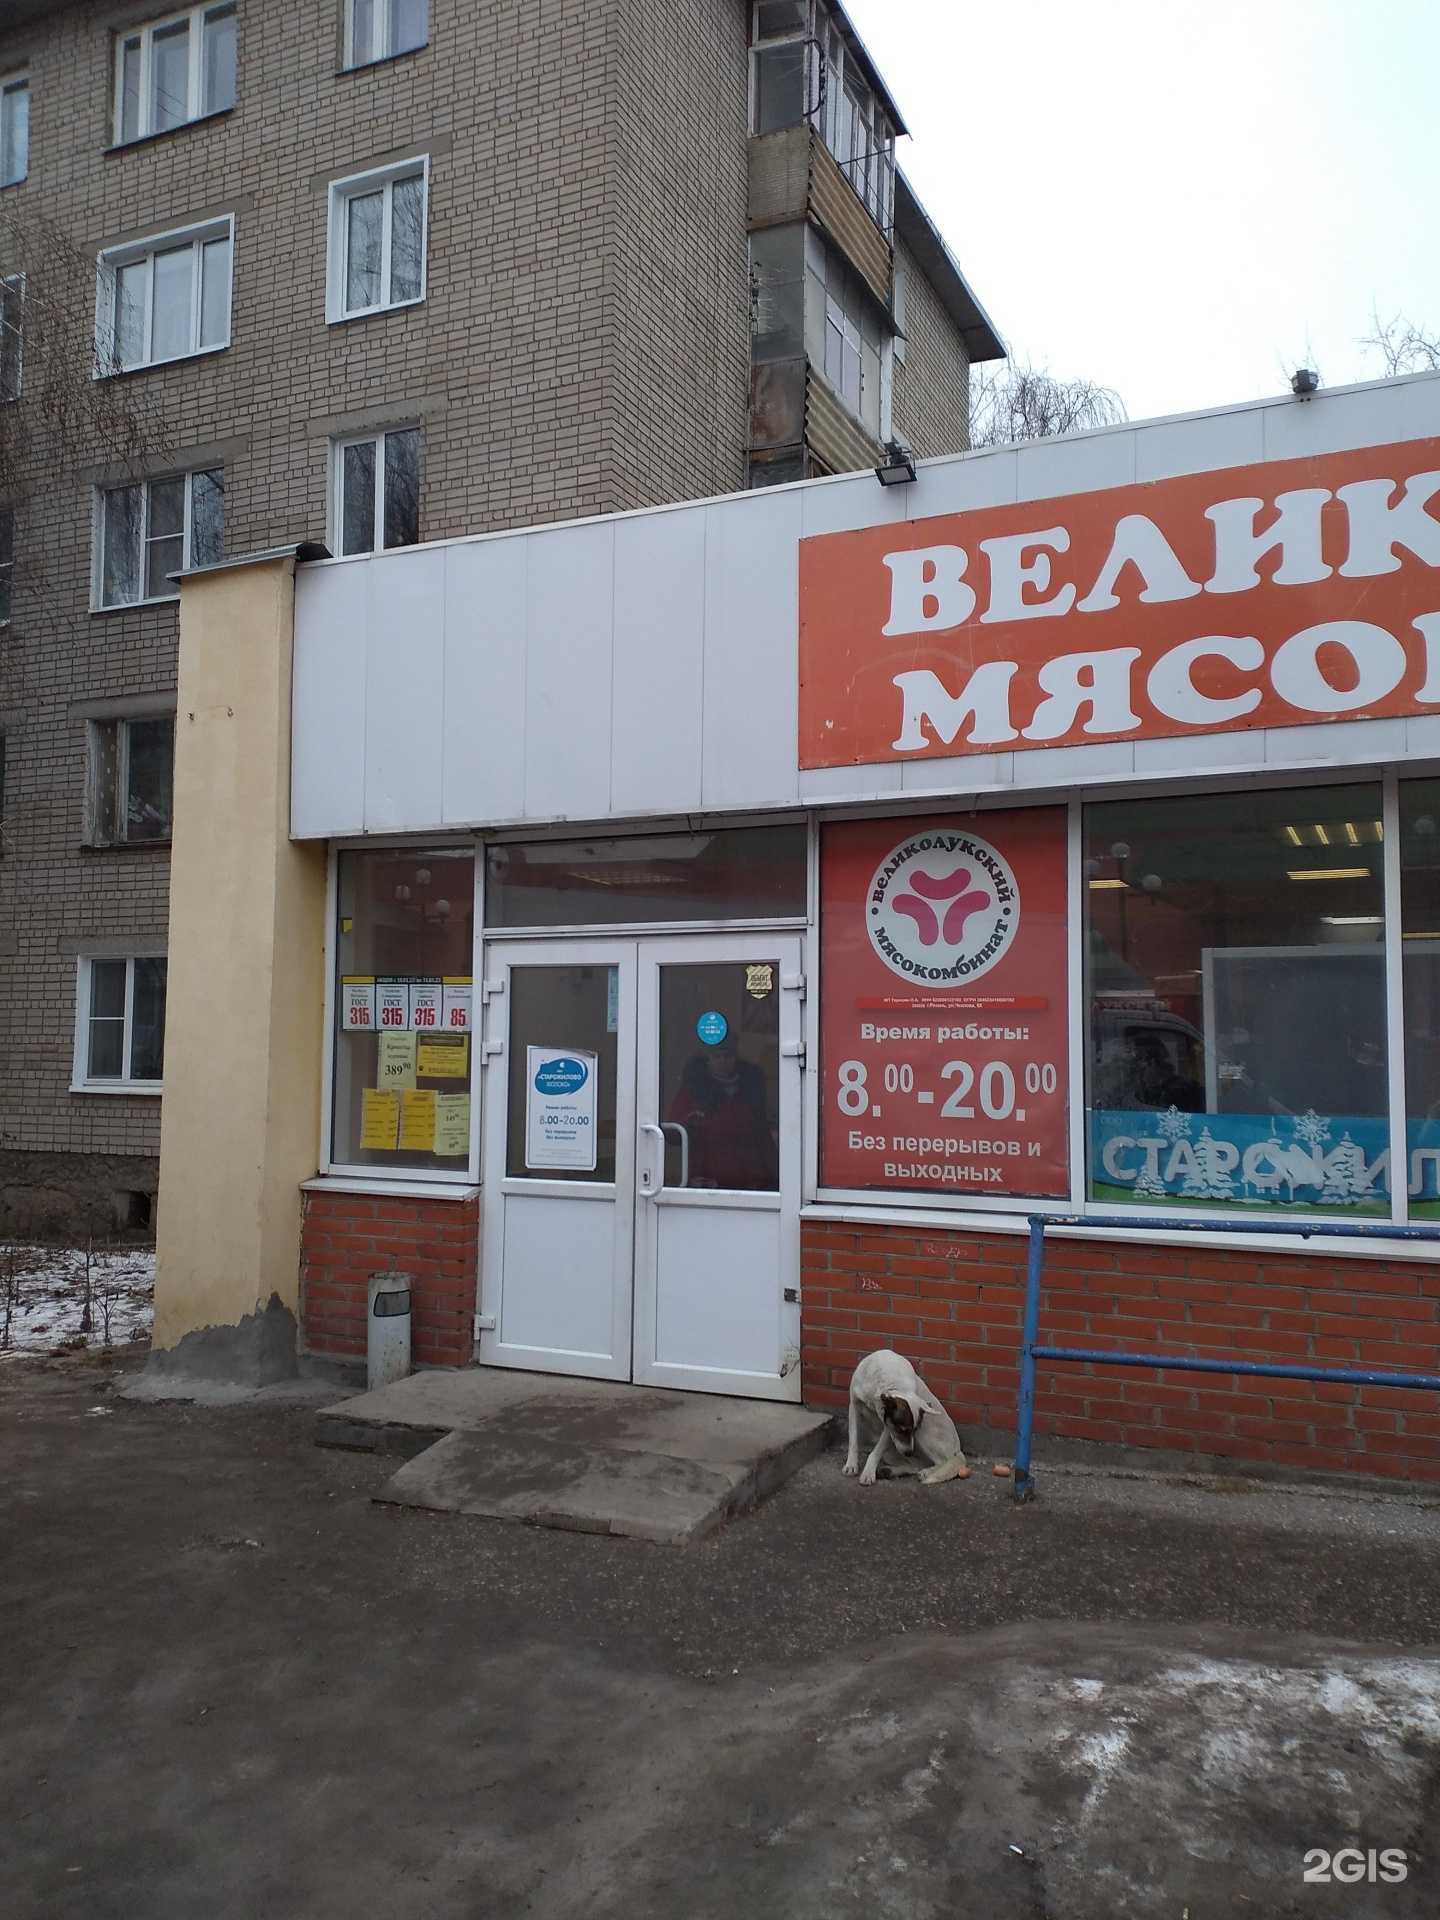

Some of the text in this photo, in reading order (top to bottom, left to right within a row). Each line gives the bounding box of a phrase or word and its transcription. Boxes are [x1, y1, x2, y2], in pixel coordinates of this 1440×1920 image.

[892, 611, 1440, 751] МЯСО
[350, 1007, 369, 1025] 315
[382, 1007, 403, 1025] 315
[415, 1007, 435, 1025] 315
[451, 1008, 467, 1026] 85
[860, 1023, 1030, 1043] Время работы:
[848, 1131, 1041, 1157] Без перерывов и
[884, 1162, 1004, 1182] выходных
